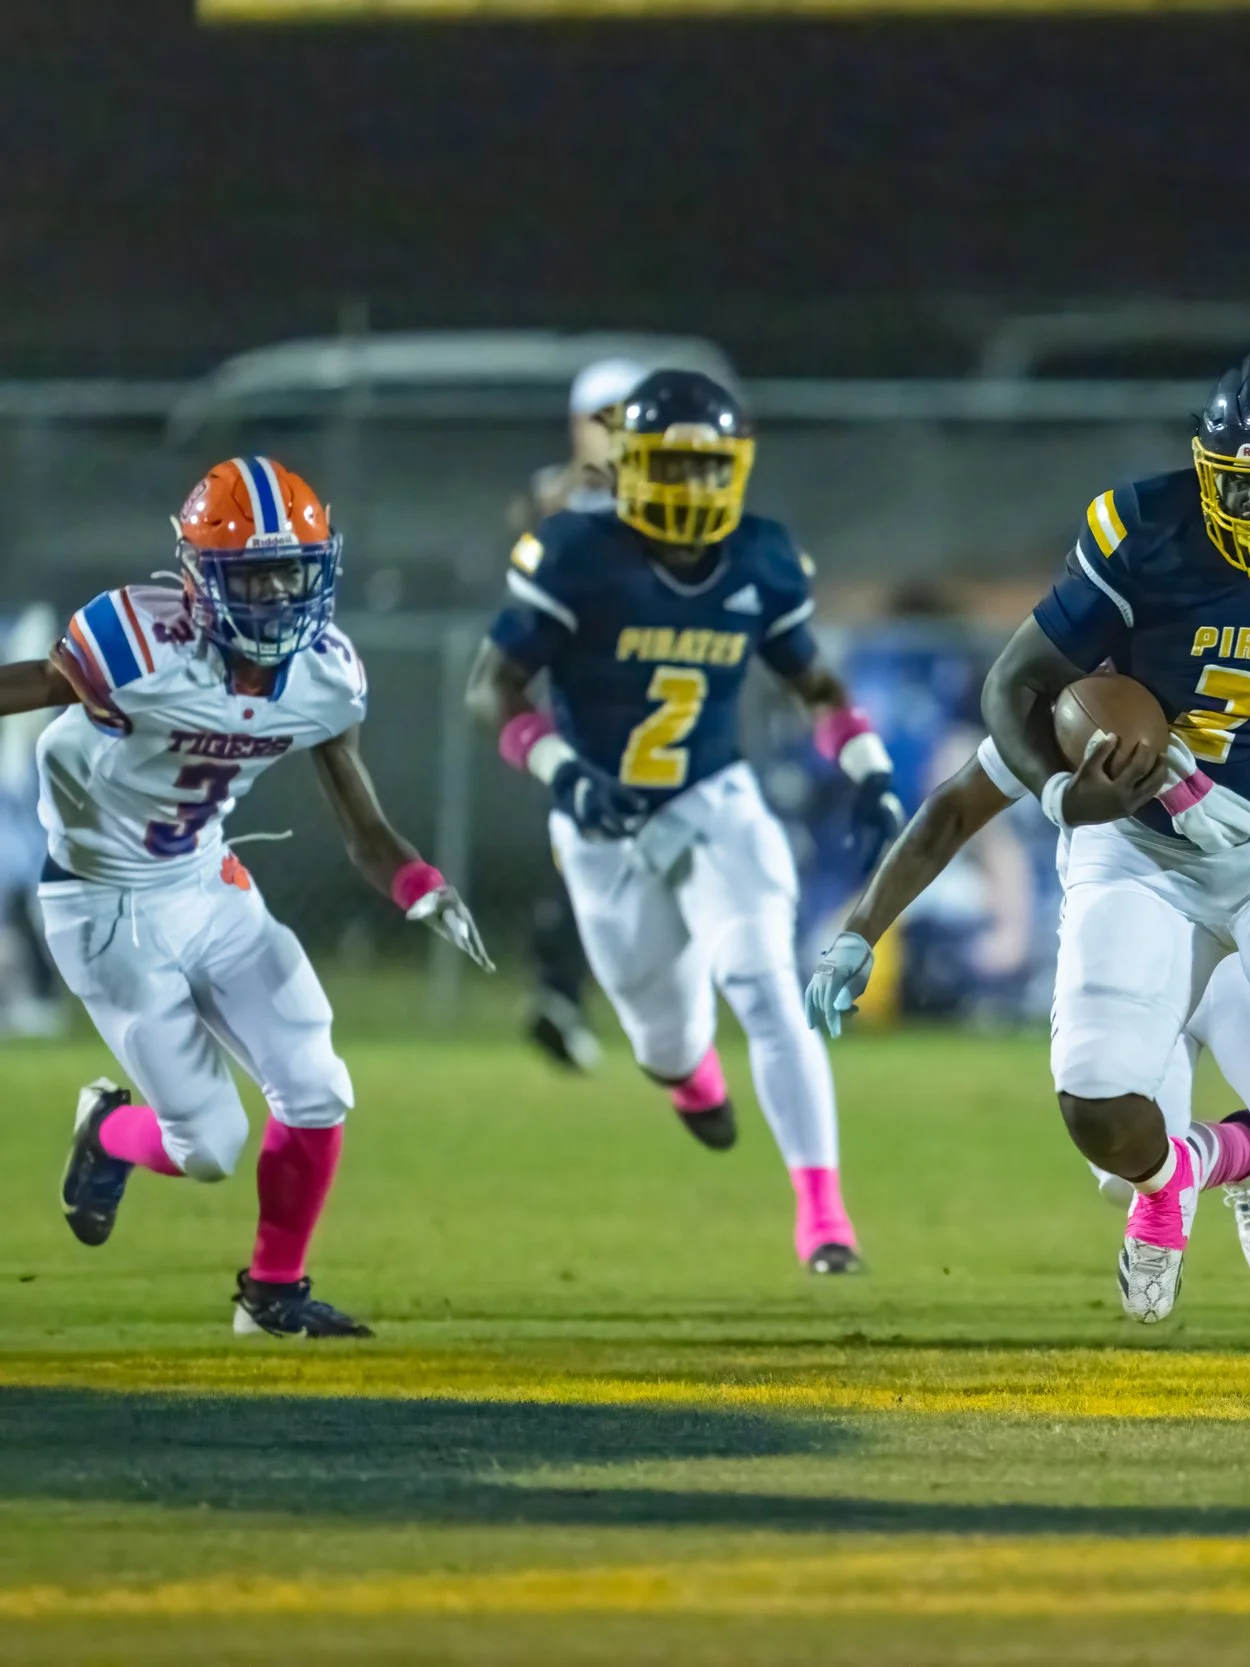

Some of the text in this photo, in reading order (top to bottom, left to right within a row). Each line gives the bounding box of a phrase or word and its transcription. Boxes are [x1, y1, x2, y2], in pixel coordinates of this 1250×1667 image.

[167, 728, 293, 760] TIGERS
[620, 666, 708, 787] 2
[143, 762, 241, 858] 3
